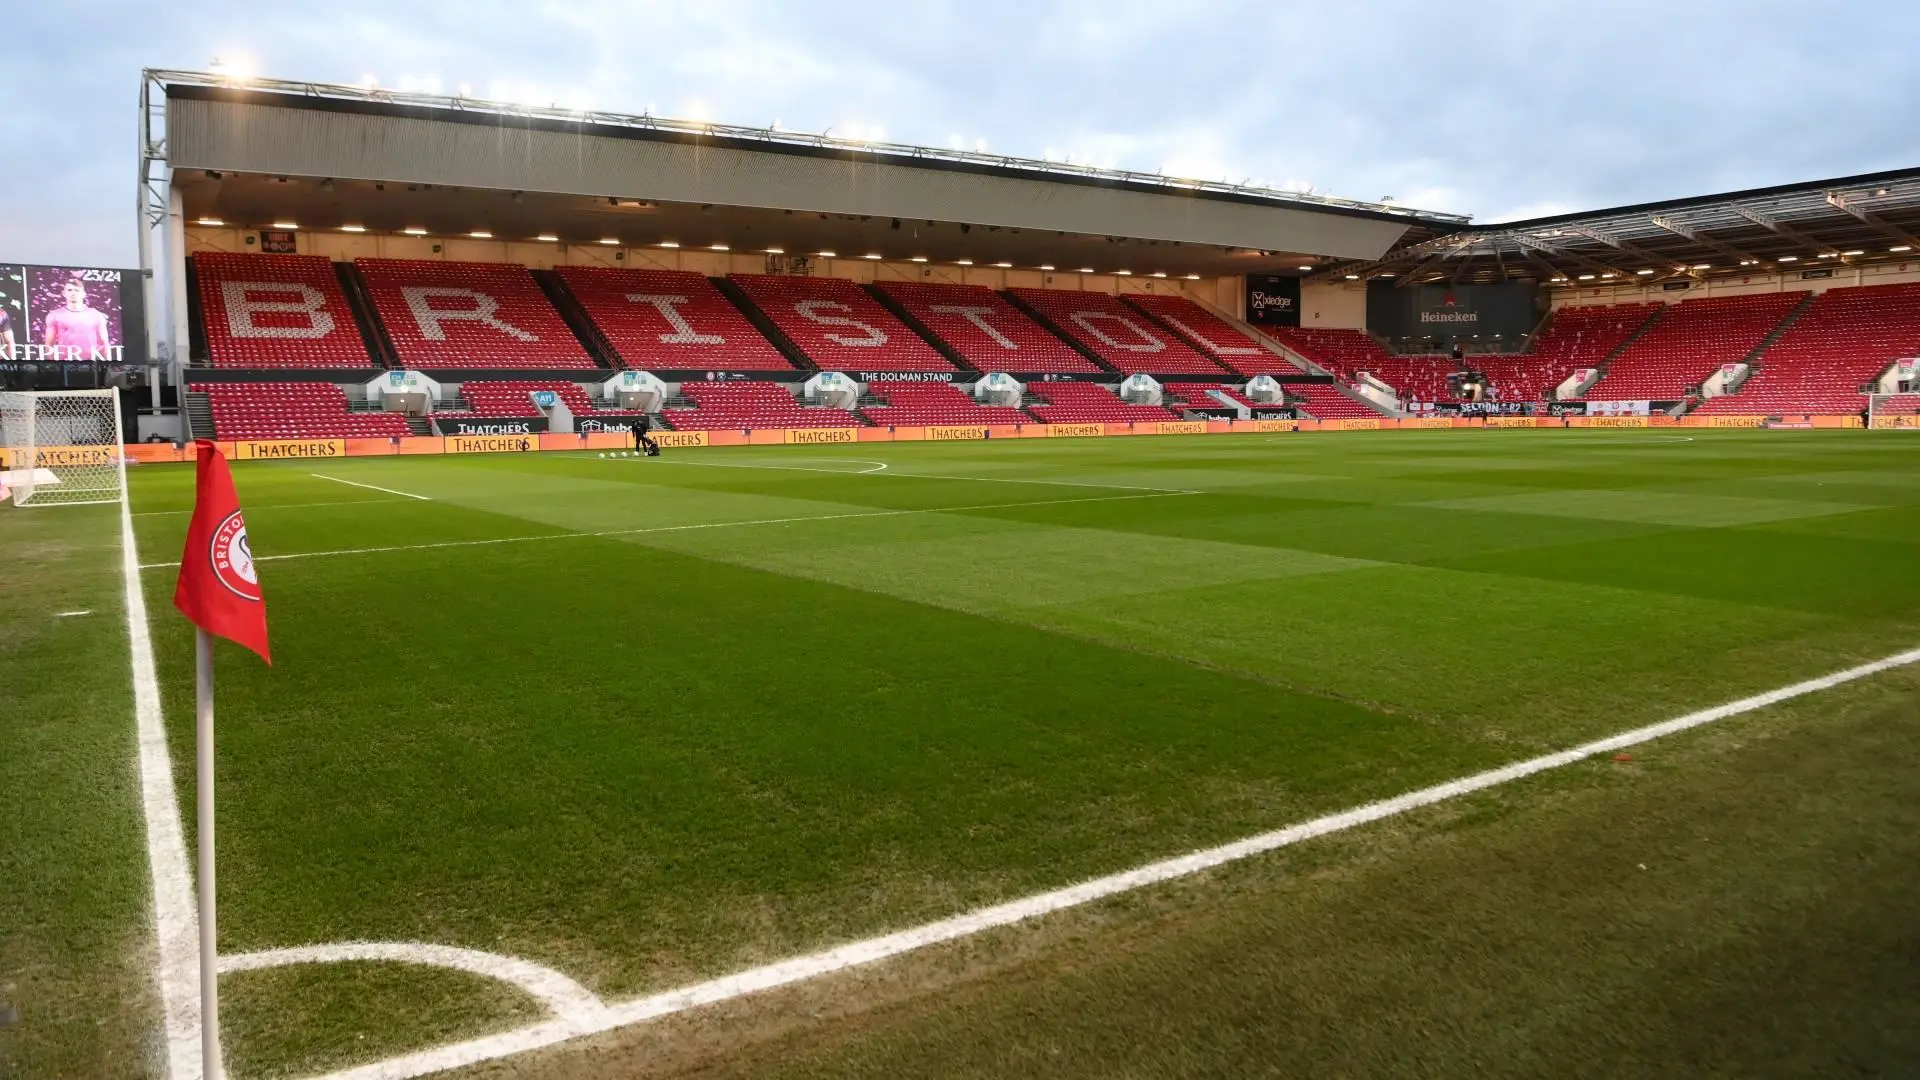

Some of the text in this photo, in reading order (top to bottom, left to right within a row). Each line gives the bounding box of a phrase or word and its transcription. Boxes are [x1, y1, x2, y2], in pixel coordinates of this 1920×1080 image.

[221, 280, 1263, 356] BRISTOL
[1420, 311, 1477, 322] Heineken
[90, 344, 124, 361] KIT
[860, 372, 952, 382] THE DOLMAN STAND
[1256, 411, 1292, 421] THATCHERS
[457, 422, 529, 436] THATCHERS
[931, 427, 983, 440] THATCHERS
[1052, 425, 1099, 436] THATCHERS
[1160, 423, 1202, 434] THATCHERS
[652, 433, 701, 446] ATCHERS
[791, 429, 851, 443] THATCHERS
[248, 441, 336, 458] THATCHERS
